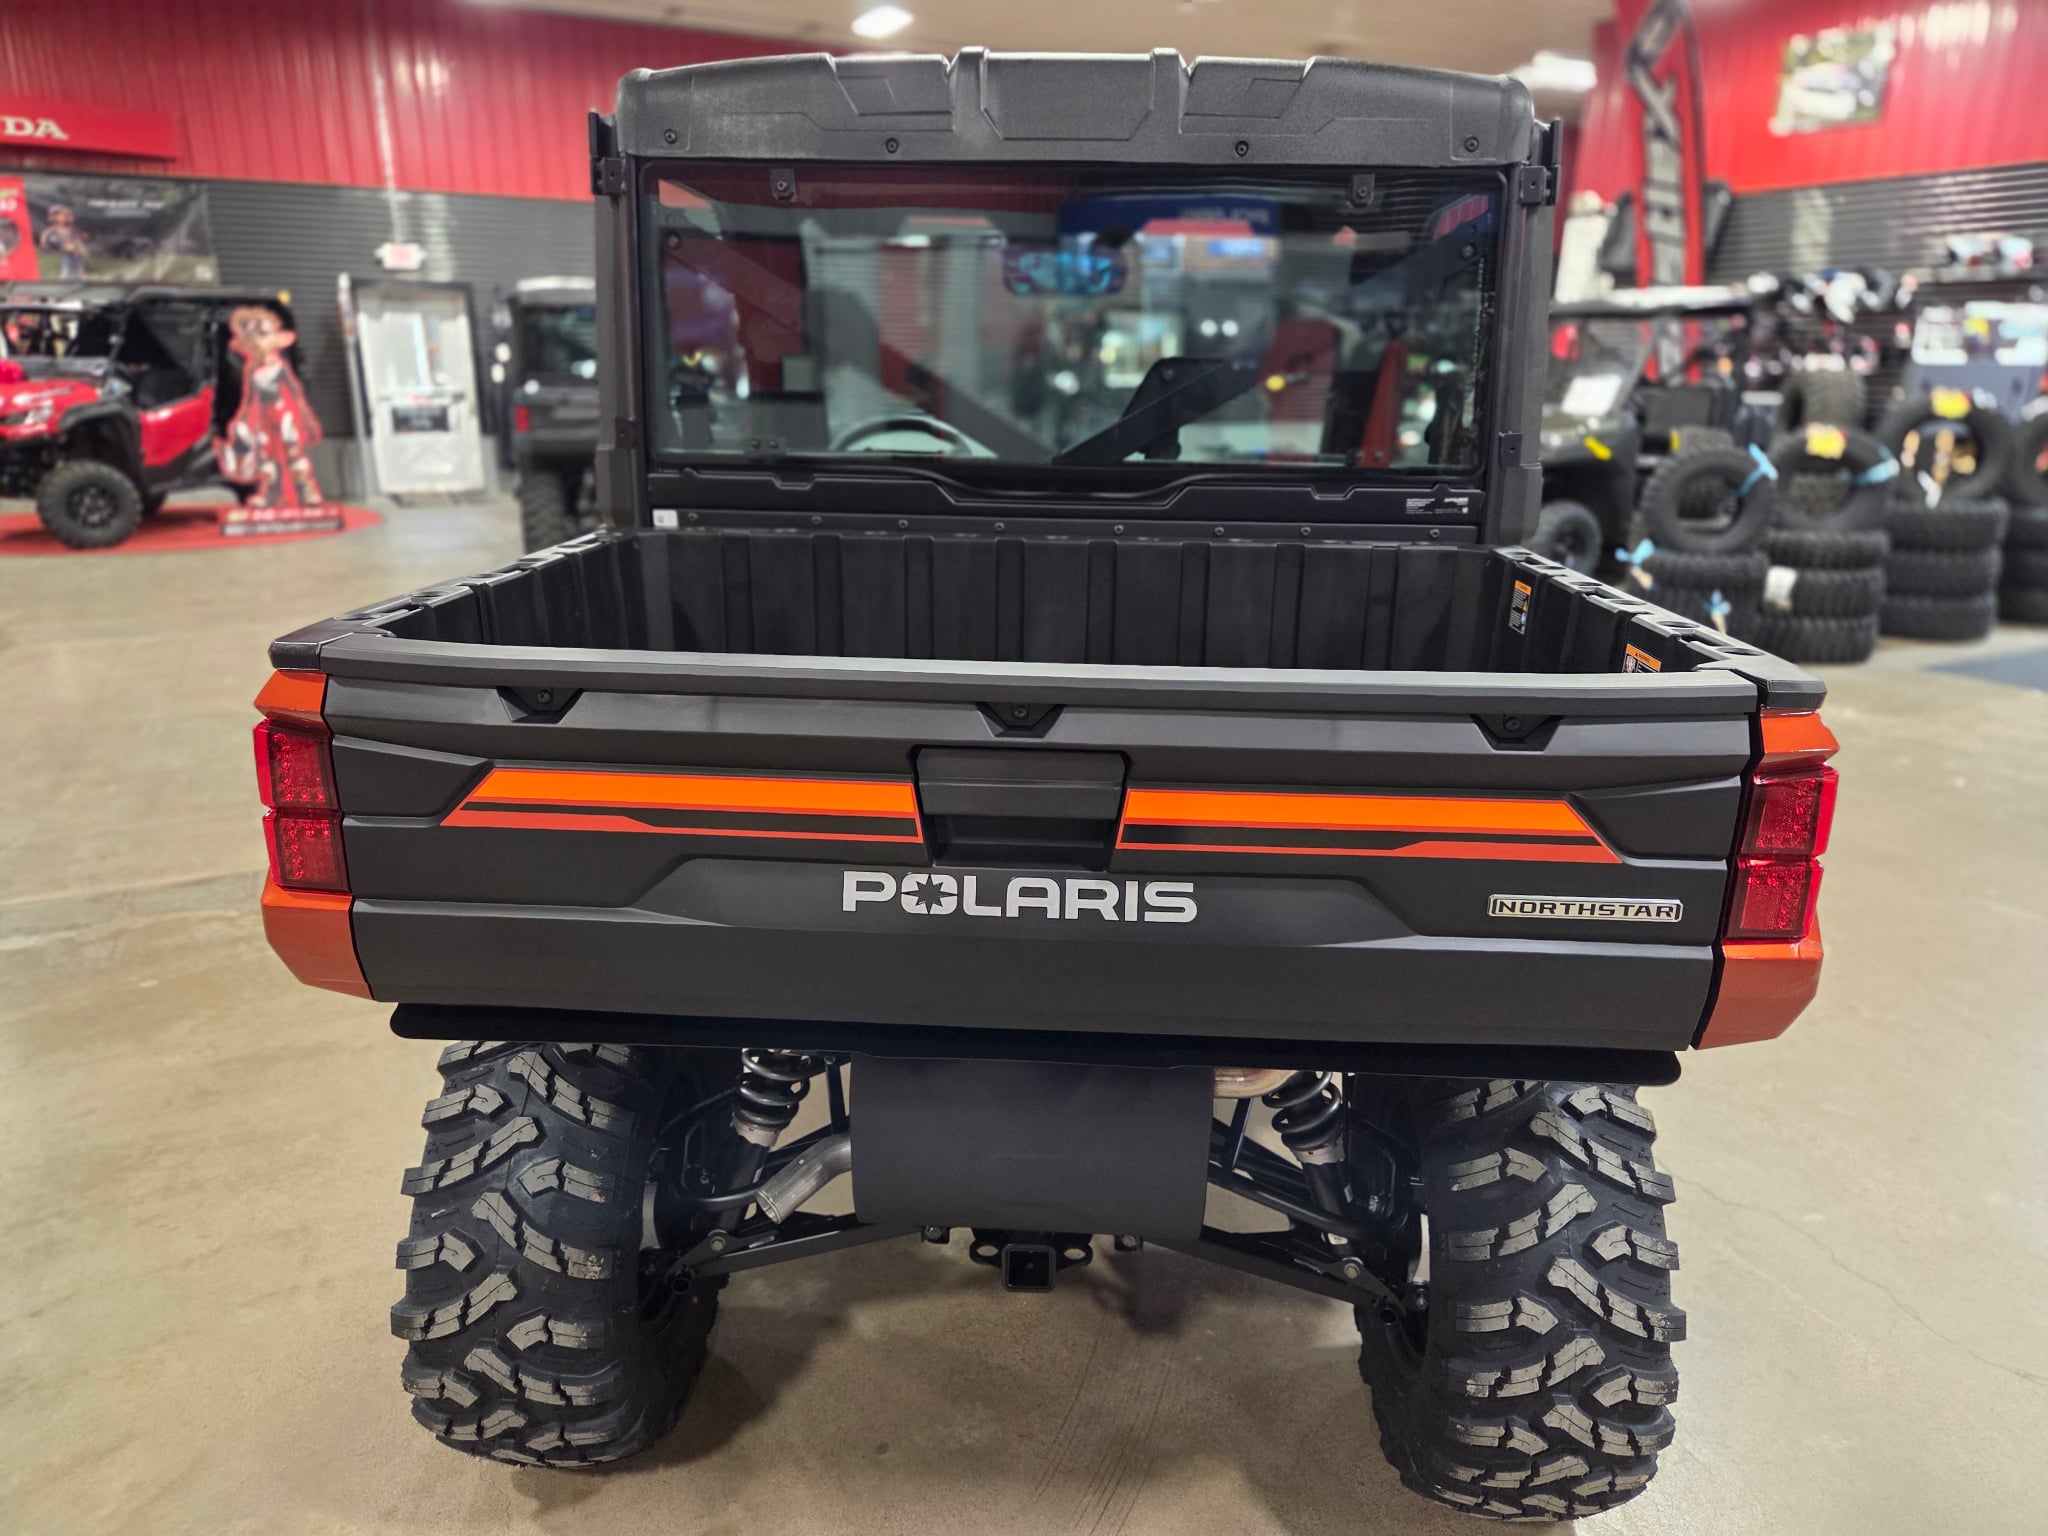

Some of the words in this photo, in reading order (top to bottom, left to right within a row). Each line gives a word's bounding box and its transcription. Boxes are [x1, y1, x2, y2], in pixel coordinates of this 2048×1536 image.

[0, 116, 69, 141] DA
[842, 870, 1198, 923] POLARIS
[1498, 901, 1674, 918] NORTHSTAR
